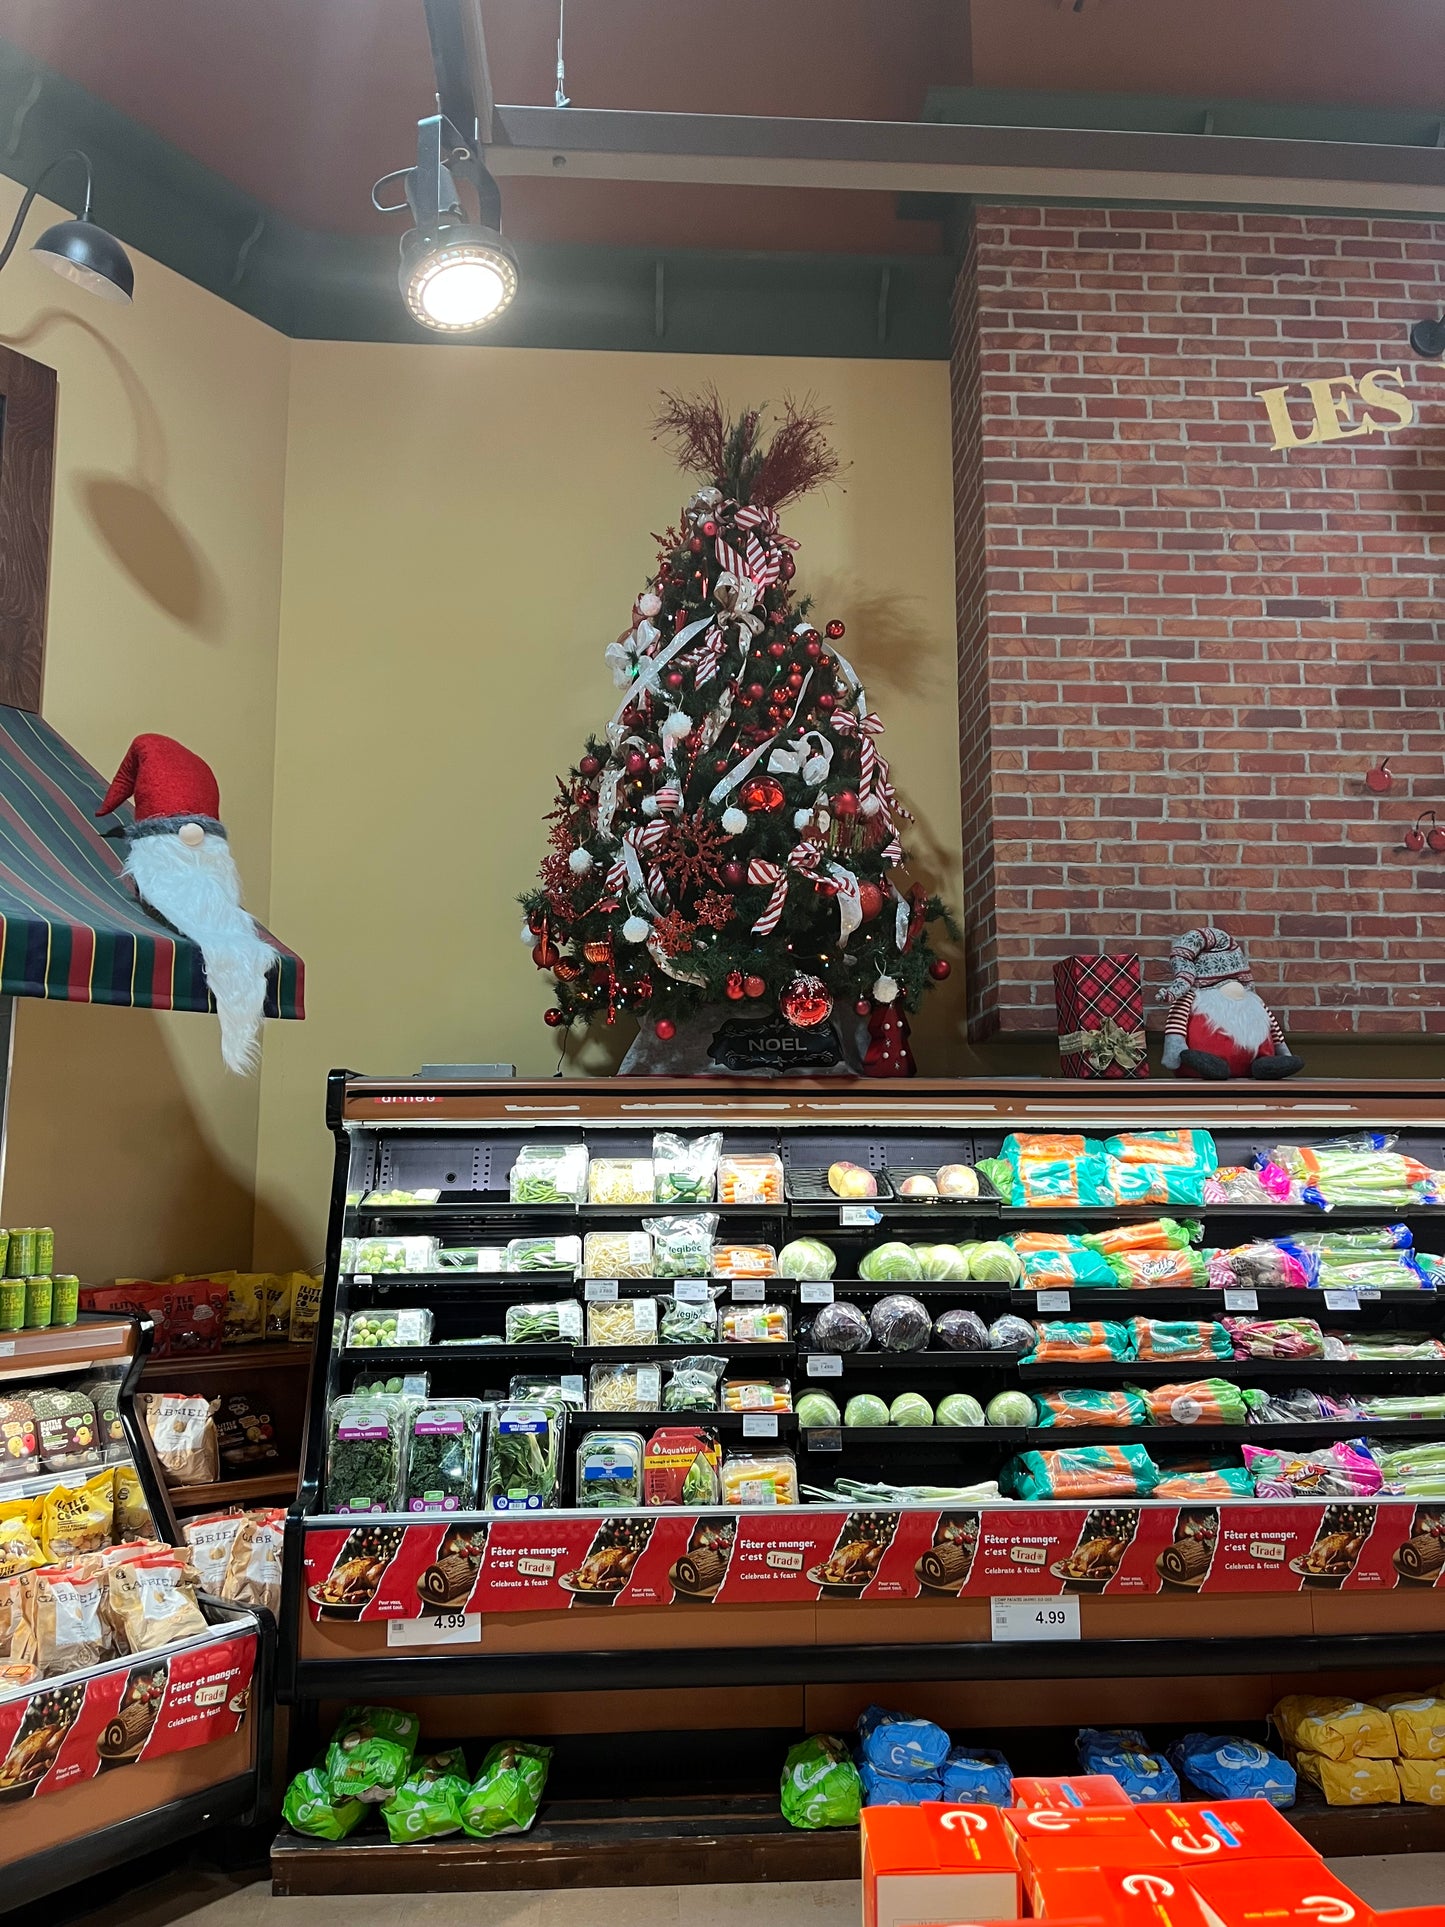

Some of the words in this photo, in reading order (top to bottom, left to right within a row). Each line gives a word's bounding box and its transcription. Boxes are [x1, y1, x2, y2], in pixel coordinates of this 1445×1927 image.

[1254, 366, 1414, 452] LES
[748, 1038, 808, 1052] NOEL
[301, 1286, 321, 1296] LITT
[297, 1293, 319, 1304] POTA
[661, 1445, 697, 1456] AquaVerti
[984, 1534, 1009, 1544] Fêter
[1011, 1536, 1021, 1544] et
[1022, 1536, 1060, 1546] manger,
[1224, 1530, 1248, 1540] Fêter
[1249, 1531, 1260, 1539] et
[1261, 1531, 1298, 1542] manger,
[740, 1539, 765, 1549] Fêter
[767, 1540, 777, 1549] et
[779, 1540, 817, 1550] manger,
[1224, 1543, 1246, 1551] c'est
[1255, 1545, 1276, 1556] Trad
[491, 1546, 516, 1556] Fêter
[518, 1547, 528, 1555] et
[530, 1547, 569, 1557] manger,
[984, 1548, 1007, 1556] c'est
[1016, 1549, 1036, 1561] Trad
[490, 1560, 514, 1568] c'est
[523, 1561, 545, 1572] Trad
[740, 1553, 763, 1561] c'est
[771, 1554, 793, 1566] Trad
[531, 1578, 548, 1586] feast
[433, 1614, 466, 1629] 4.99
[1035, 1610, 1066, 1624] 4.99
[170, 1680, 194, 1694] Fêter
[195, 1676, 206, 1686] et
[206, 1667, 241, 1683] manger,
[169, 1694, 192, 1707] c'est
[200, 1689, 218, 1702] Trad
[167, 1714, 198, 1728] Celebrate
[199, 1711, 205, 1719] &
[206, 1706, 221, 1718] feast
